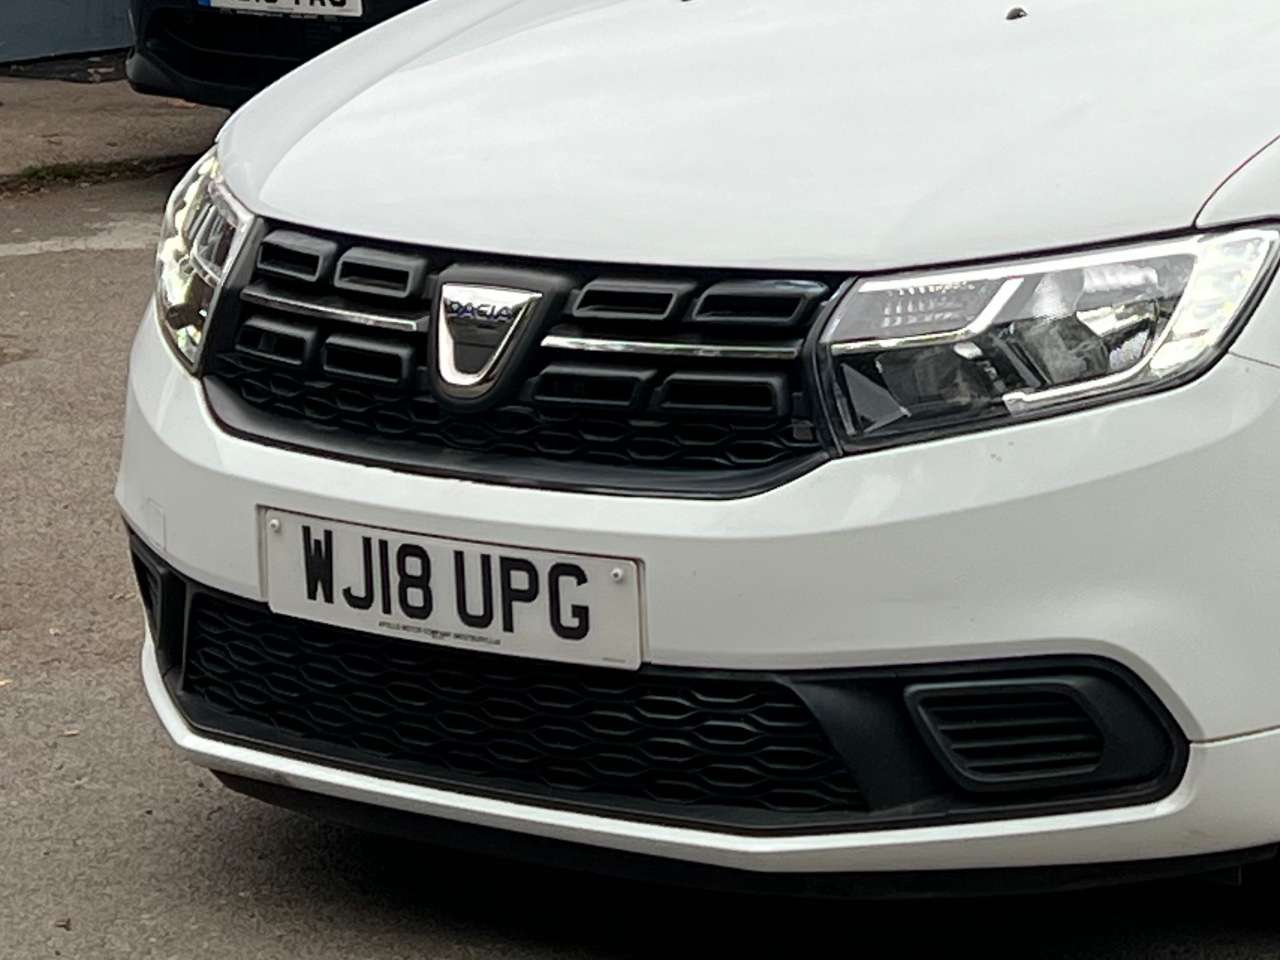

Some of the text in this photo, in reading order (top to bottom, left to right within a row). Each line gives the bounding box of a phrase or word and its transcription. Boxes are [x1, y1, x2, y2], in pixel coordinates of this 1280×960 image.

[449, 301, 513, 320] DACIA
[302, 526, 590, 641] WJ18 UPG
